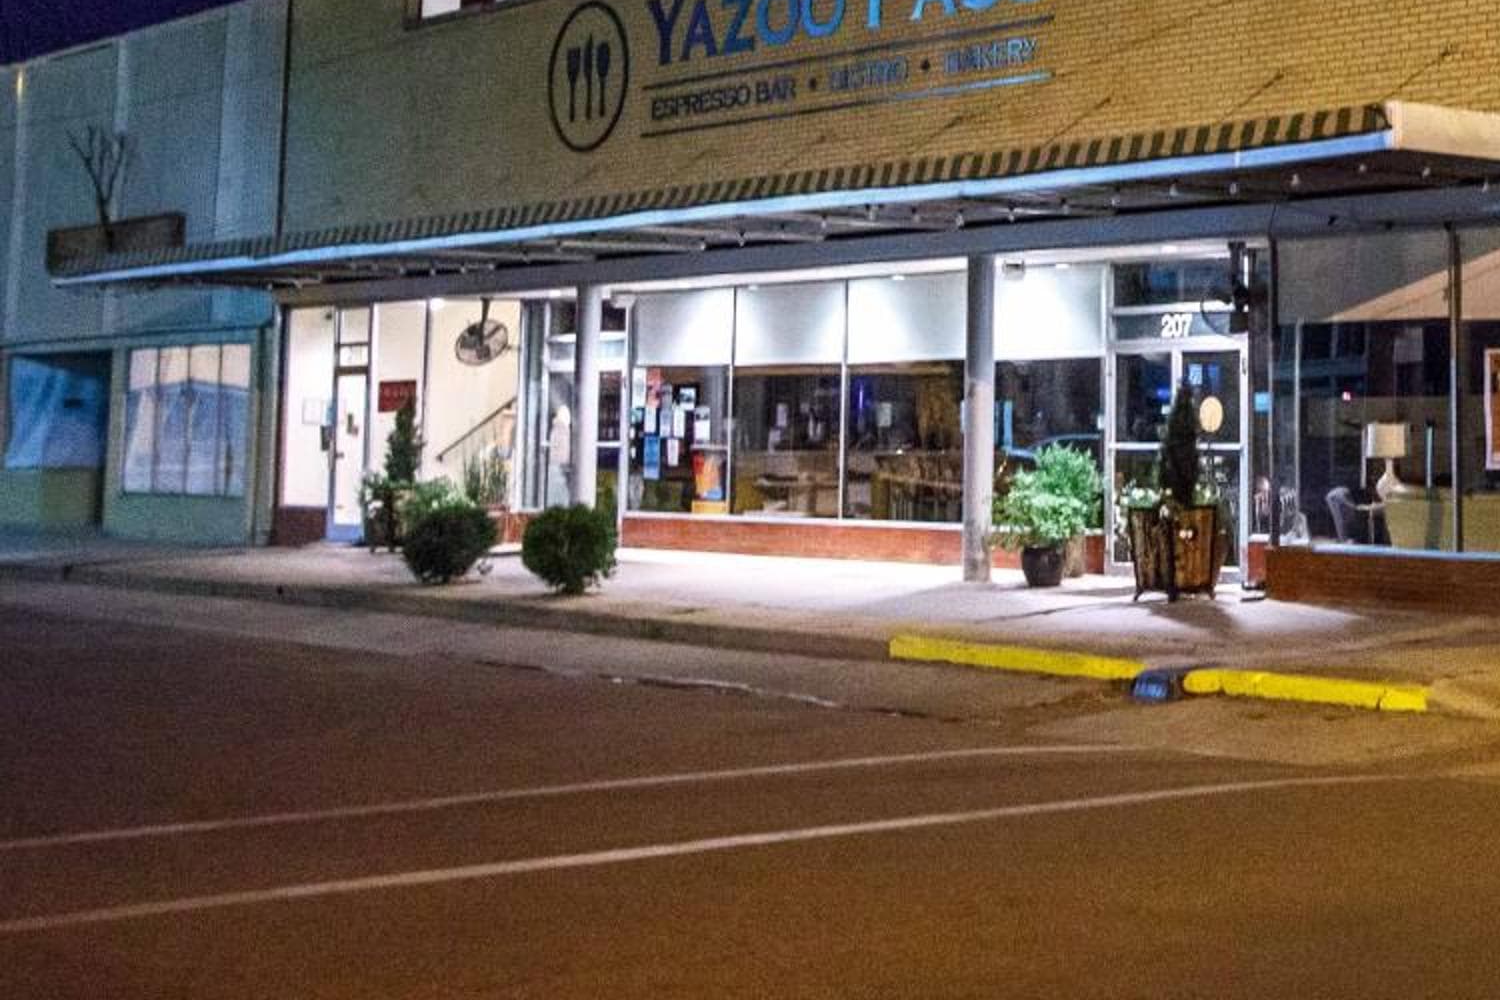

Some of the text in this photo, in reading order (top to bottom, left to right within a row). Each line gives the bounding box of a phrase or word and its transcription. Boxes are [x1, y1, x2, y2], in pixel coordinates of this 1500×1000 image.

[651, 86, 750, 120] ESPRESSO
[756, 77, 797, 104] BAR
[944, 37, 1037, 74] BAKERY
[1161, 313, 1192, 337] 207
